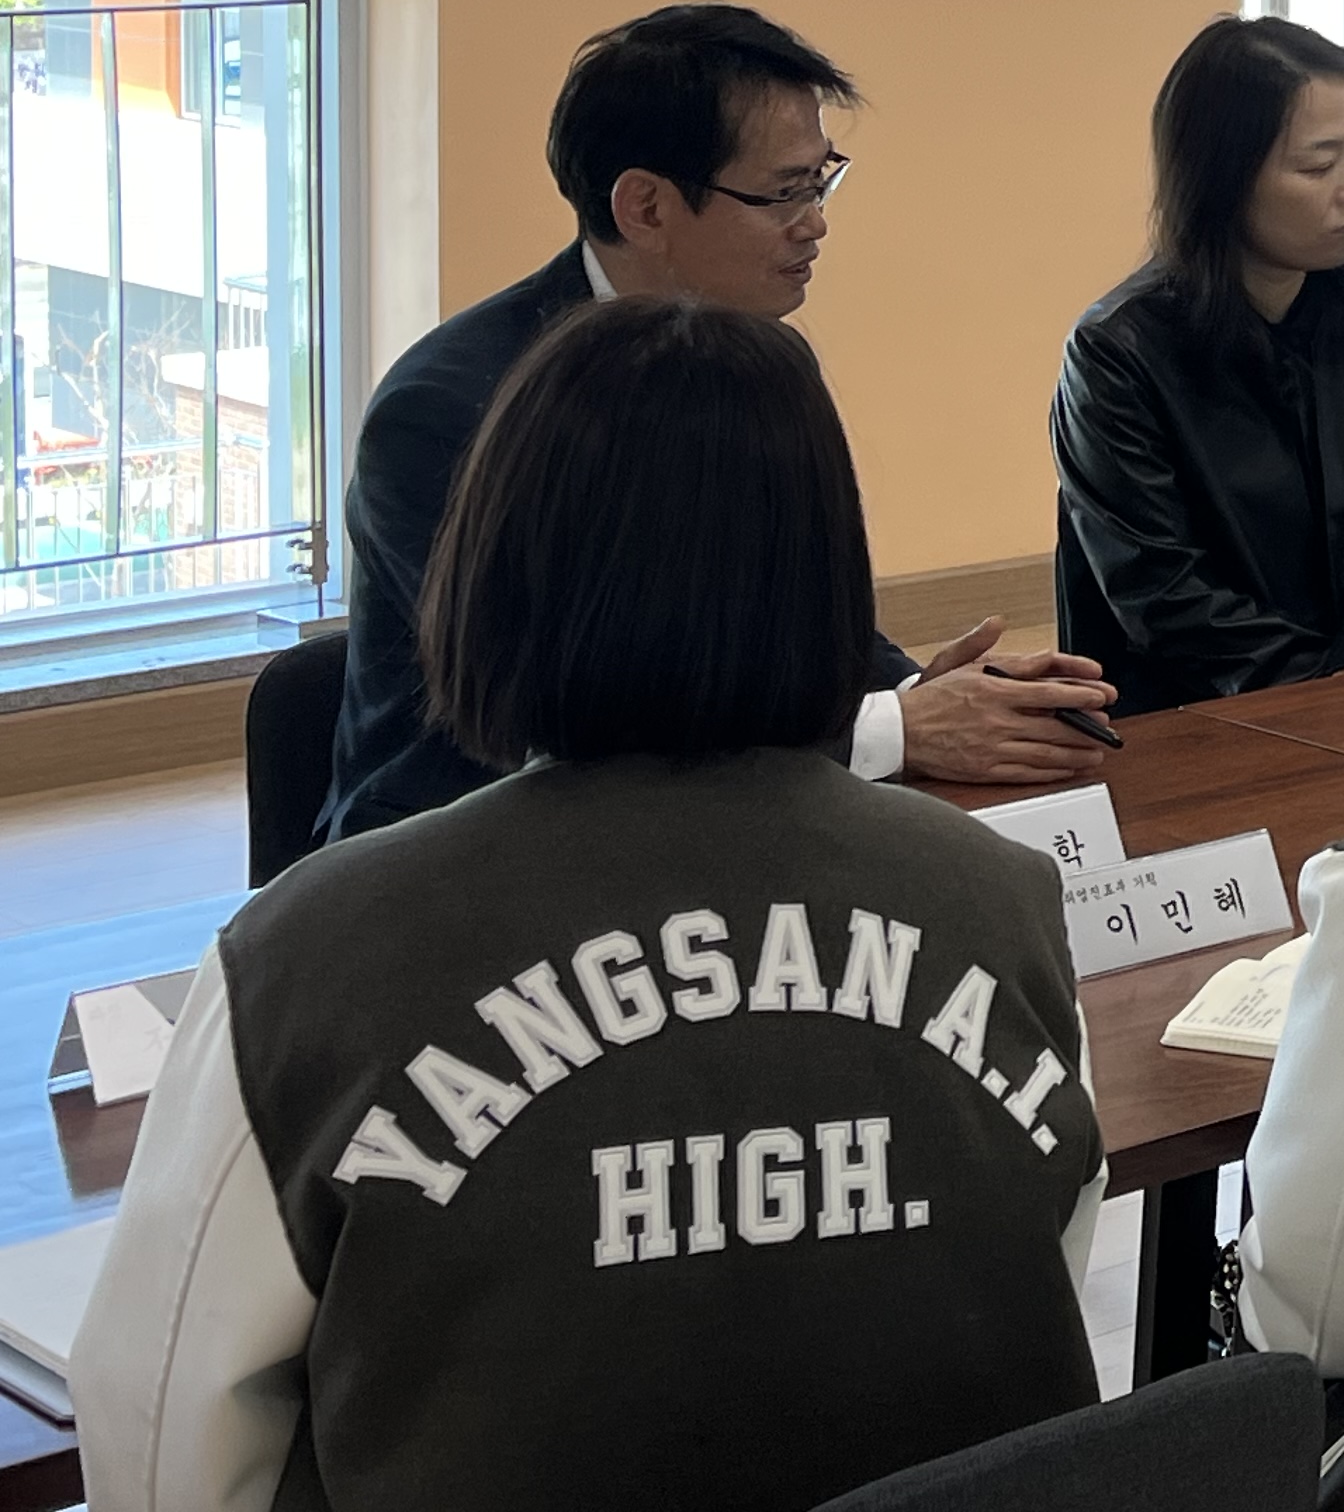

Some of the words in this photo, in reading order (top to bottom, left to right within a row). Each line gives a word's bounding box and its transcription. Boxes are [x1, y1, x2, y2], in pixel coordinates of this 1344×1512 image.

[332, 902, 922, 1208] YANGSAN
[920, 963, 1068, 1157] A.I.
[591, 1116, 931, 1268] HIGH.
